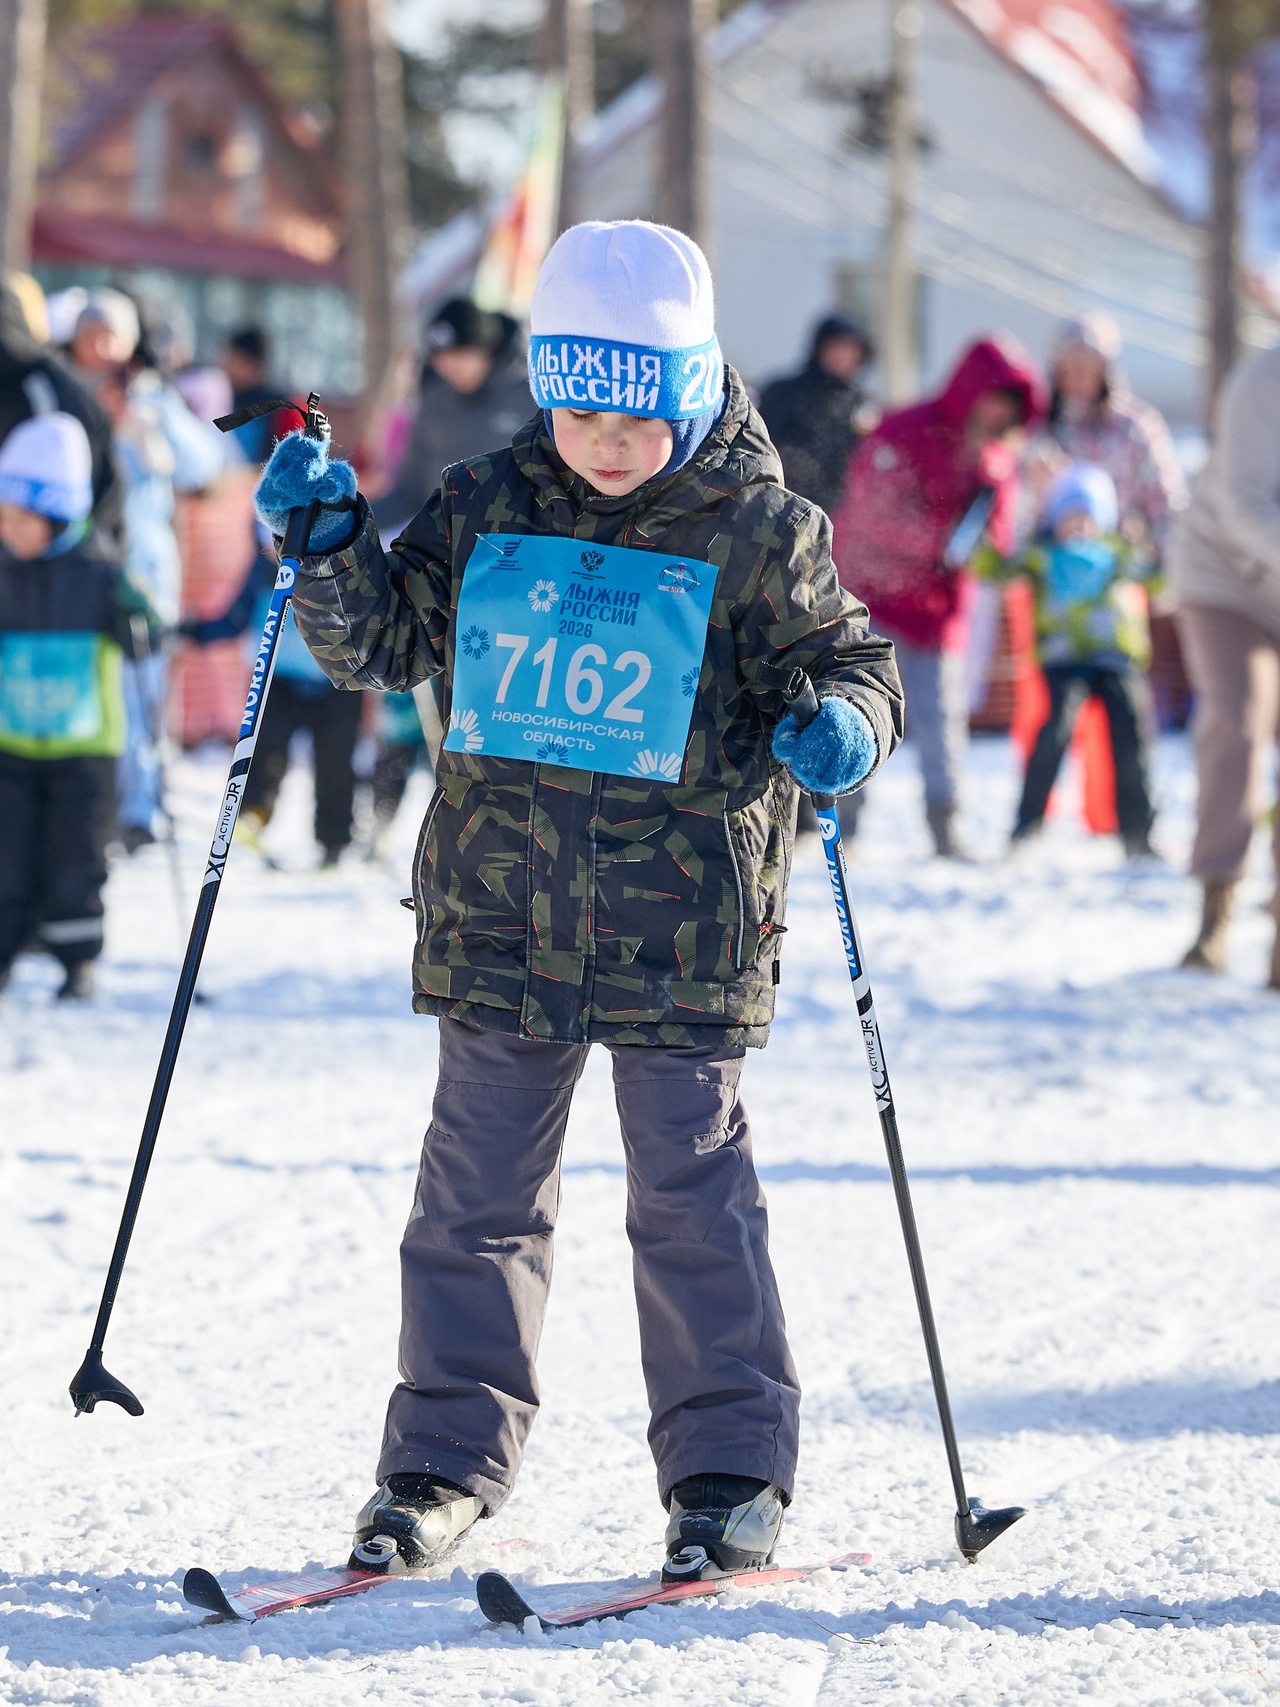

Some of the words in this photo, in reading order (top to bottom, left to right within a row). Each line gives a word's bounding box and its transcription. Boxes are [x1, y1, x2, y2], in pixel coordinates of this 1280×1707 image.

[537, 343, 661, 385] ЛЫЖНЯ
[538, 374, 660, 411] РОССИИ
[563, 583, 641, 609] ЛЫЖНЯ
[558, 619, 593, 639] 2026
[559, 600, 637, 627] РОССИИ
[241, 608, 278, 726] NORDWAY
[495, 632, 652, 724] 7162
[491, 710, 645, 742] НОВОСИБИРСКАЯ
[523, 730, 596, 752] ОБЛАСТЬ
[204, 841, 229, 879] XC
[218, 805, 233, 842] ACTIVE
[226, 782, 241, 803] JR
[861, 1019, 875, 1037] JR
[865, 1040, 879, 1073] ACTIVE
[872, 1070, 893, 1103] XC
